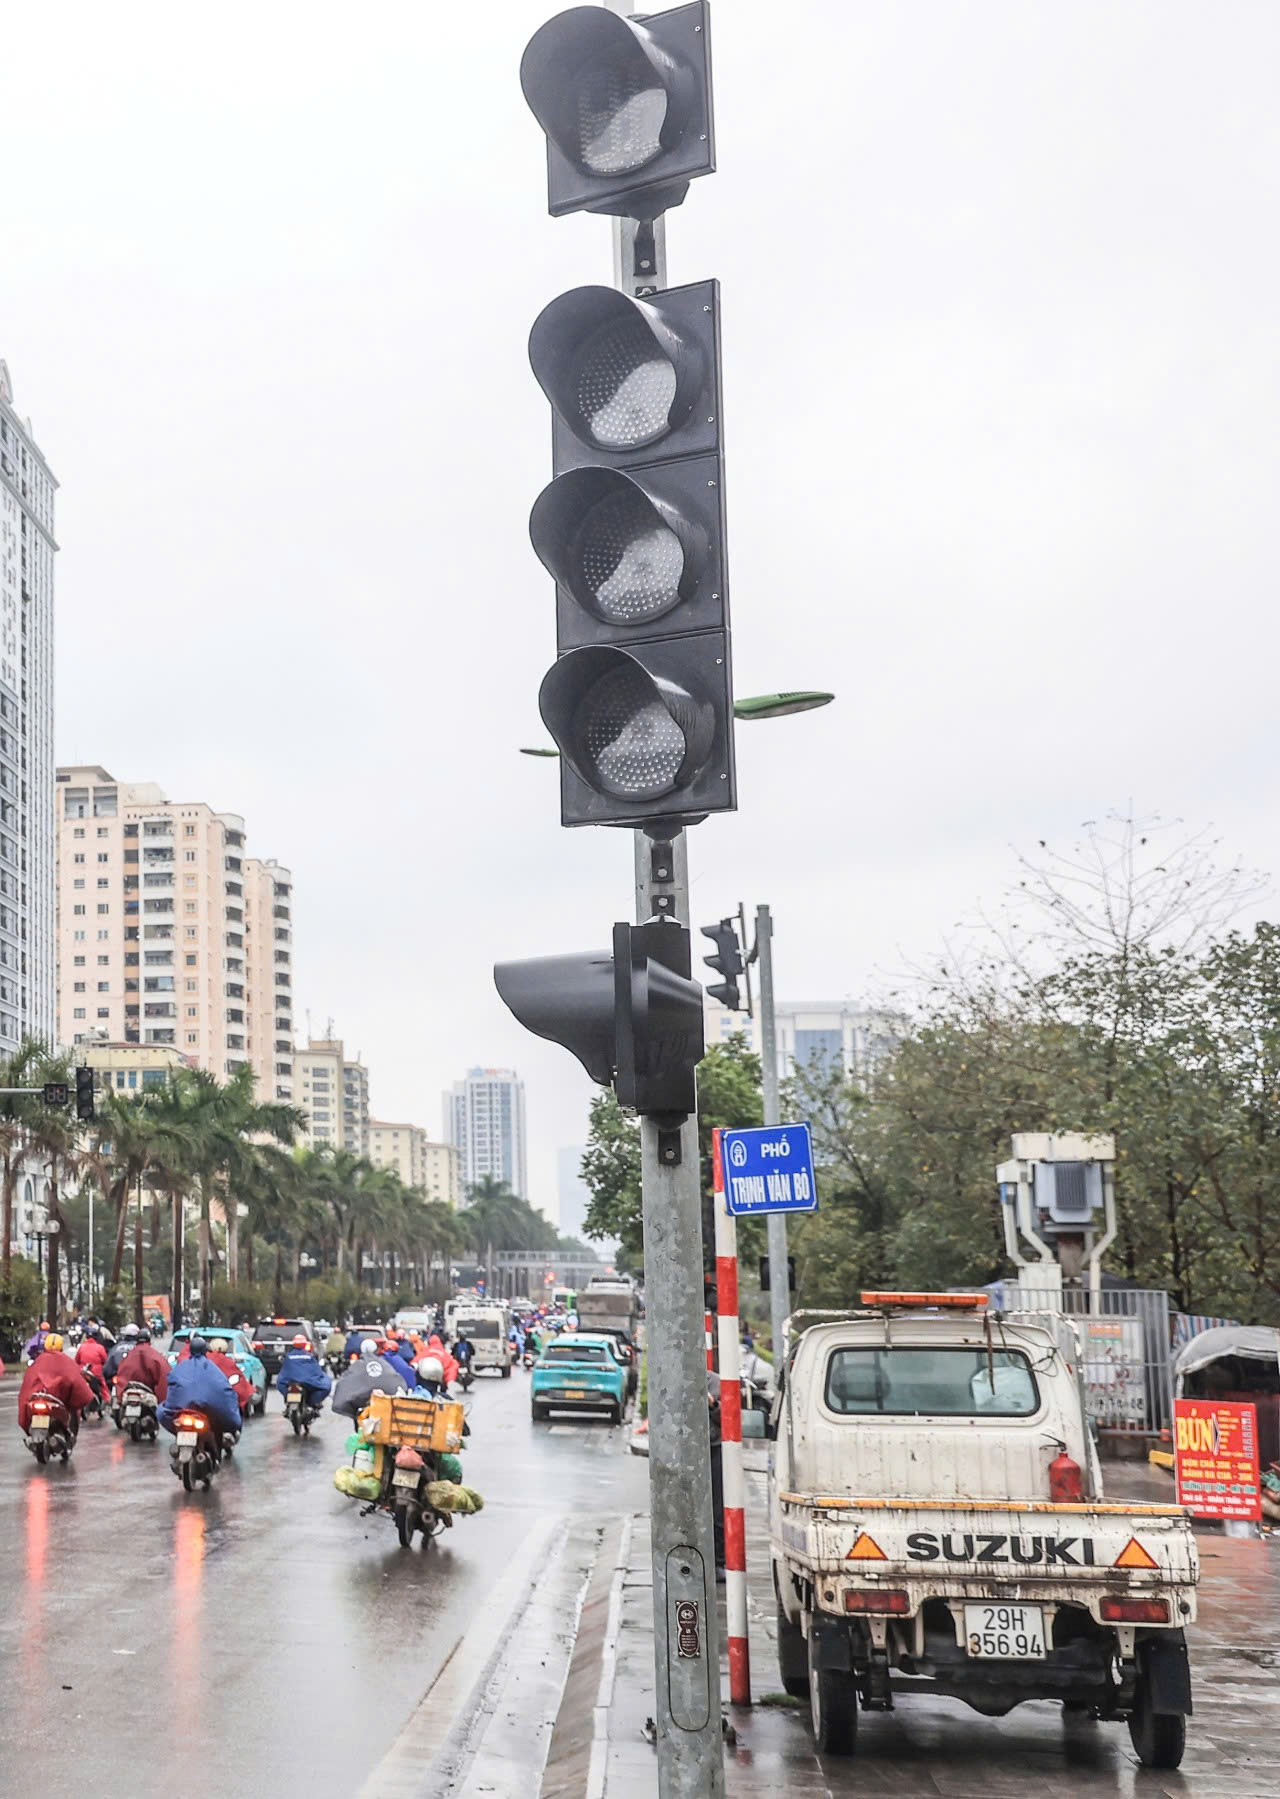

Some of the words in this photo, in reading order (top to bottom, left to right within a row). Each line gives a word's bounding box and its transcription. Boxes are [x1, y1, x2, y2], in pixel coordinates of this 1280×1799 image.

[760, 1134, 791, 1158] PHỐ
[731, 1175, 766, 1208] TRỊNH
[766, 1168, 792, 1202] VĂN
[906, 1533, 1096, 1565] SUZUKI
[983, 1608, 1025, 1631] 29H
[969, 1633, 1043, 1656] 356.94
